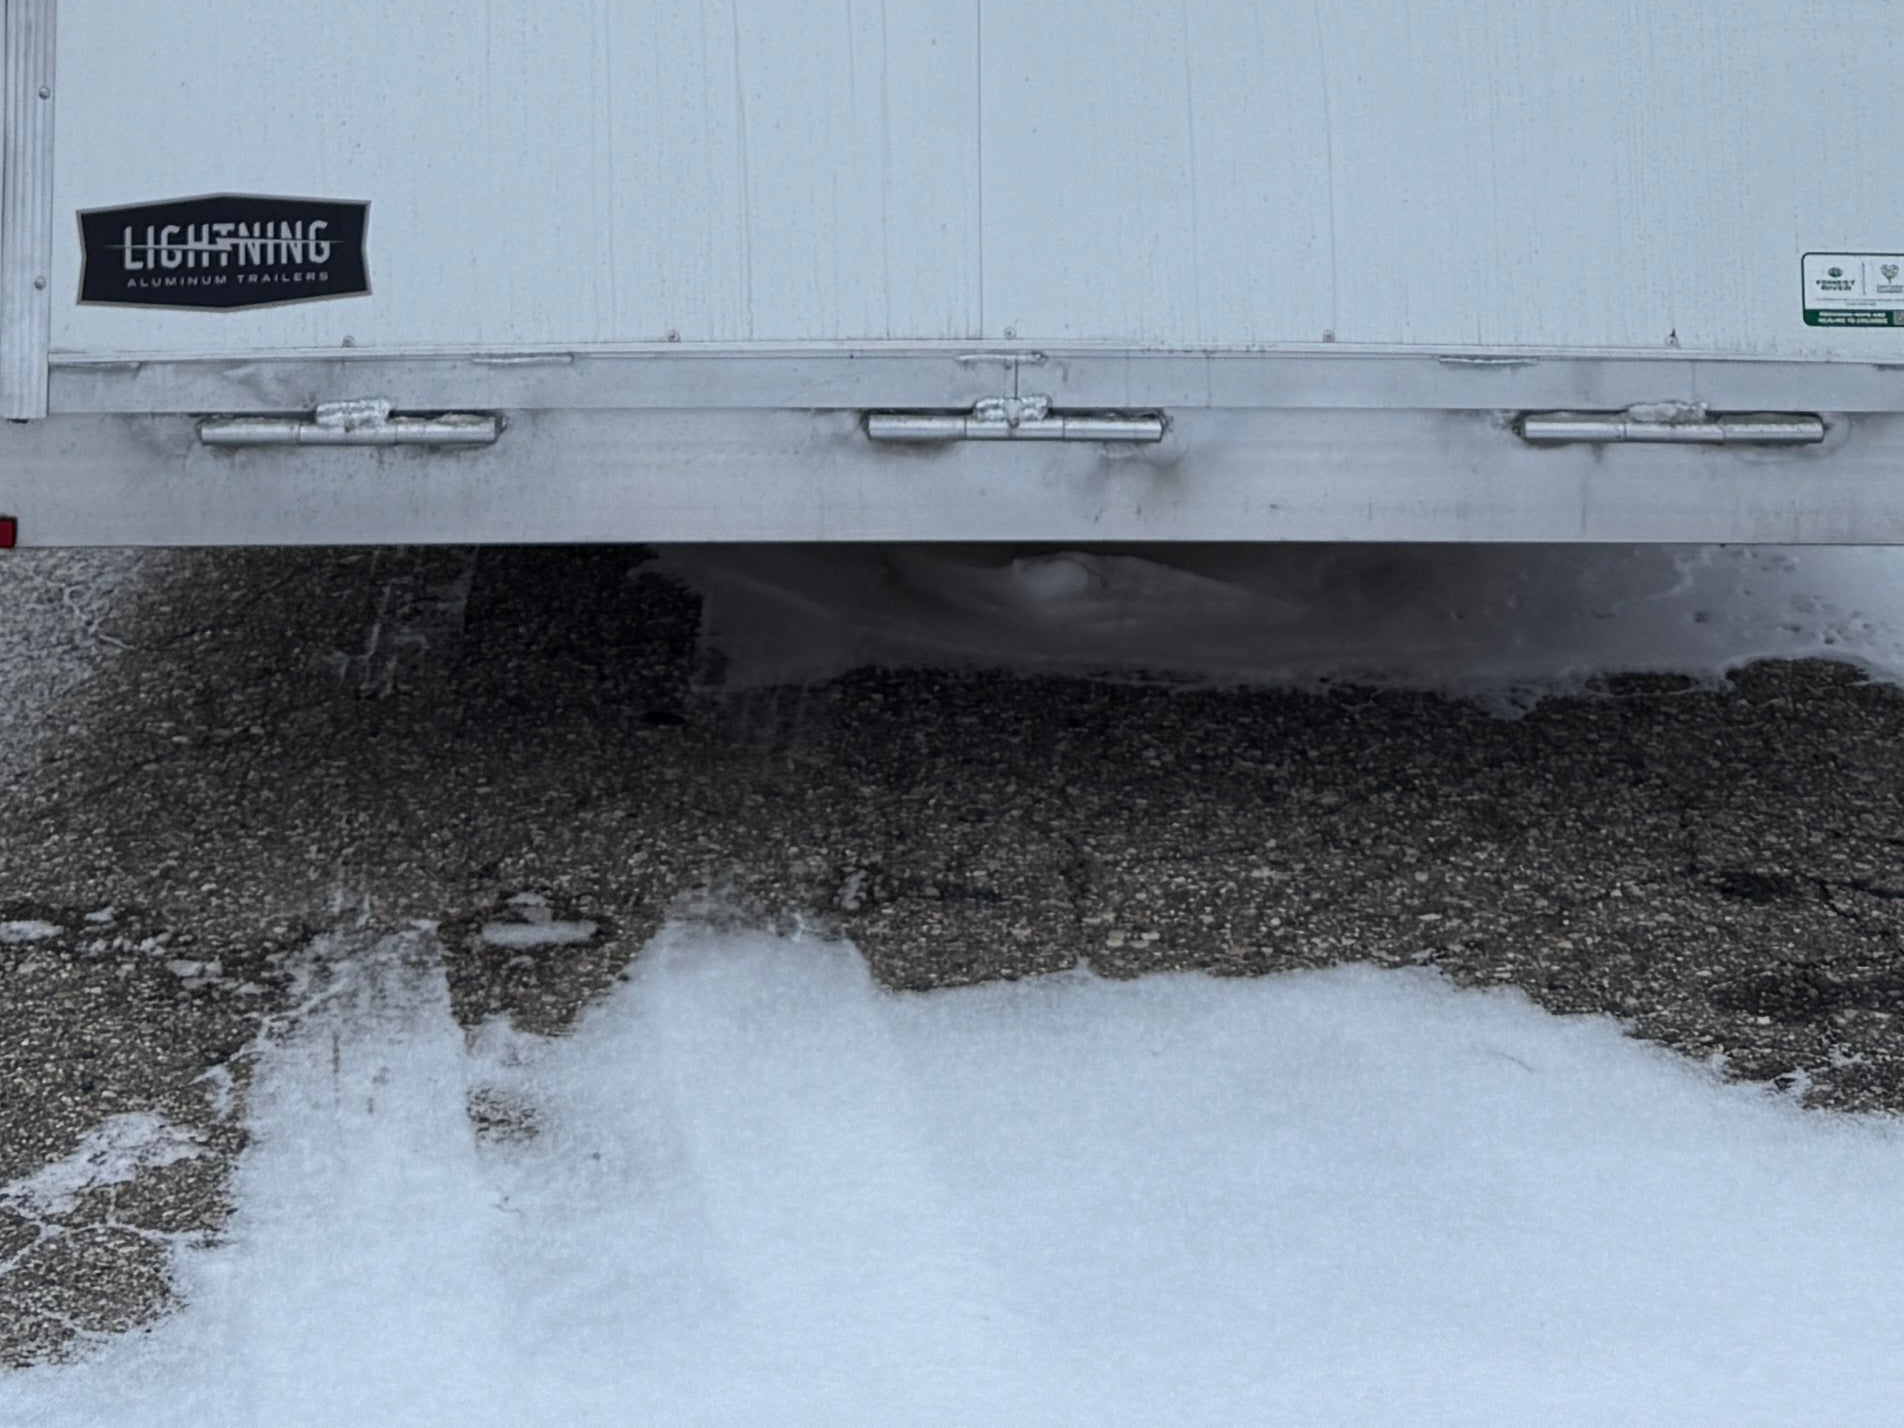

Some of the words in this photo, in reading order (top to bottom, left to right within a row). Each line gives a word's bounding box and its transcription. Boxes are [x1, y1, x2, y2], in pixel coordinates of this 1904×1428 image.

[123, 219, 331, 271] LIGHTNING
[127, 274, 228, 289] ALUMINUM
[237, 271, 330, 284] TRAILERS
